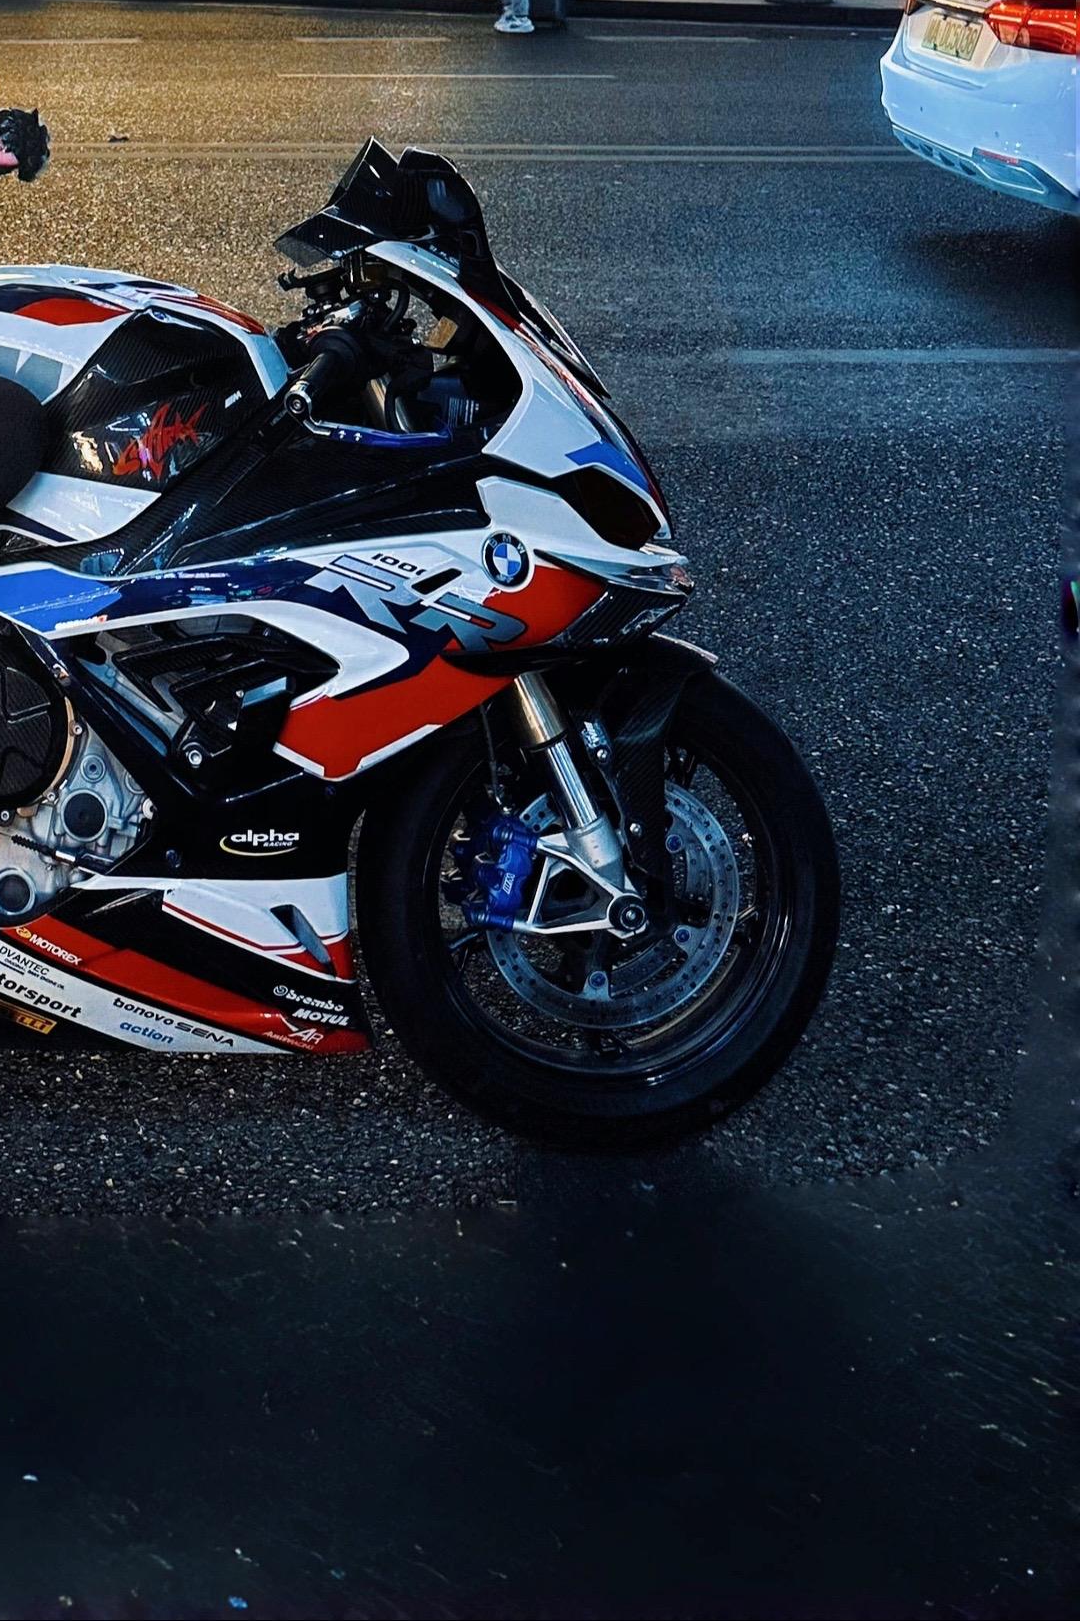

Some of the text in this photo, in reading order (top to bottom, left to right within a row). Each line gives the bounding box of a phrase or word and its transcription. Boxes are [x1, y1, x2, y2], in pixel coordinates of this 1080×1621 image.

[230, 828, 300, 847] alpha
[29, 933, 83, 966] MOTOREX
[113, 998, 175, 1025] bonovo
[285, 989, 344, 1012] brembo
[292, 1008, 350, 1027] MOTUL
[120, 1022, 174, 1044] action
[175, 1021, 234, 1047] SENA
